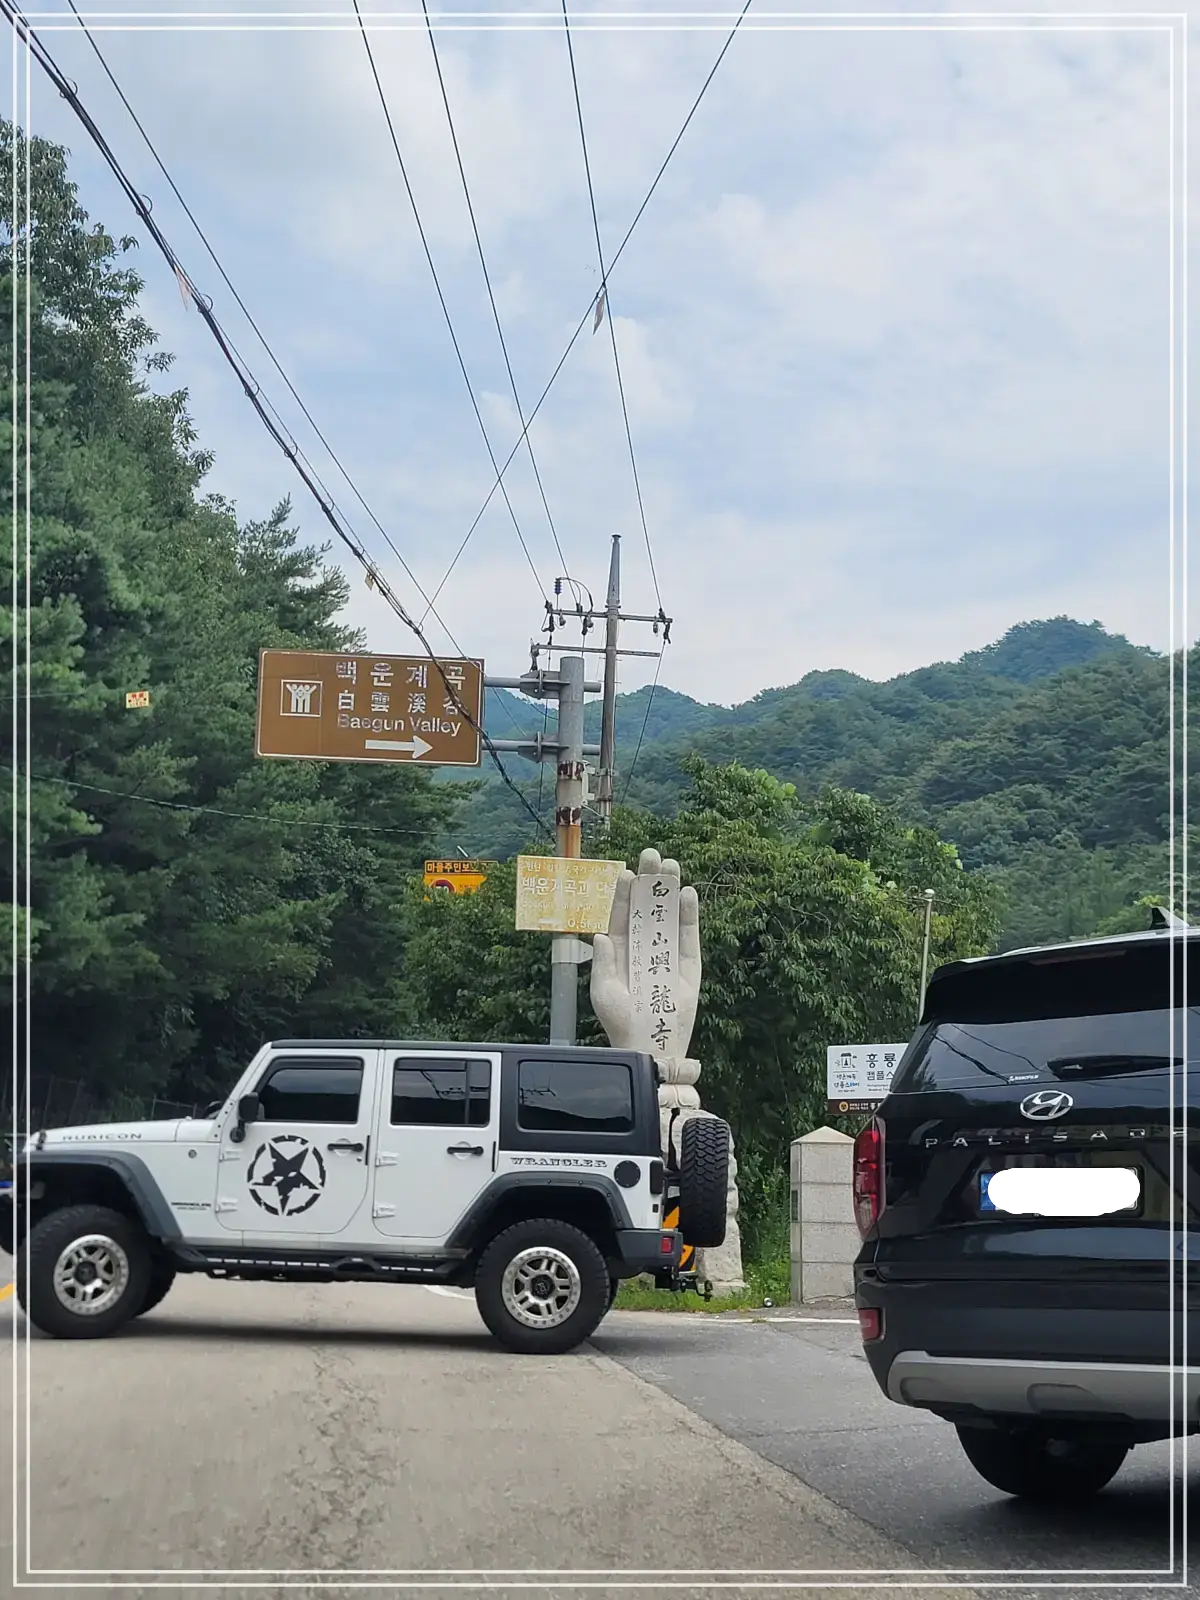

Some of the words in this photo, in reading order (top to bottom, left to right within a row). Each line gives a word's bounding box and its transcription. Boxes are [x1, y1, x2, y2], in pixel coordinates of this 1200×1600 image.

[336, 661, 467, 691] 백운계곡
[337, 714, 405, 733] Baegun
[410, 716, 462, 737] Valley
[62, 1133, 143, 1141] RUBICON
[925, 1126, 1188, 1148] PALISADE
[510, 1157, 608, 1168] WRANGLER
